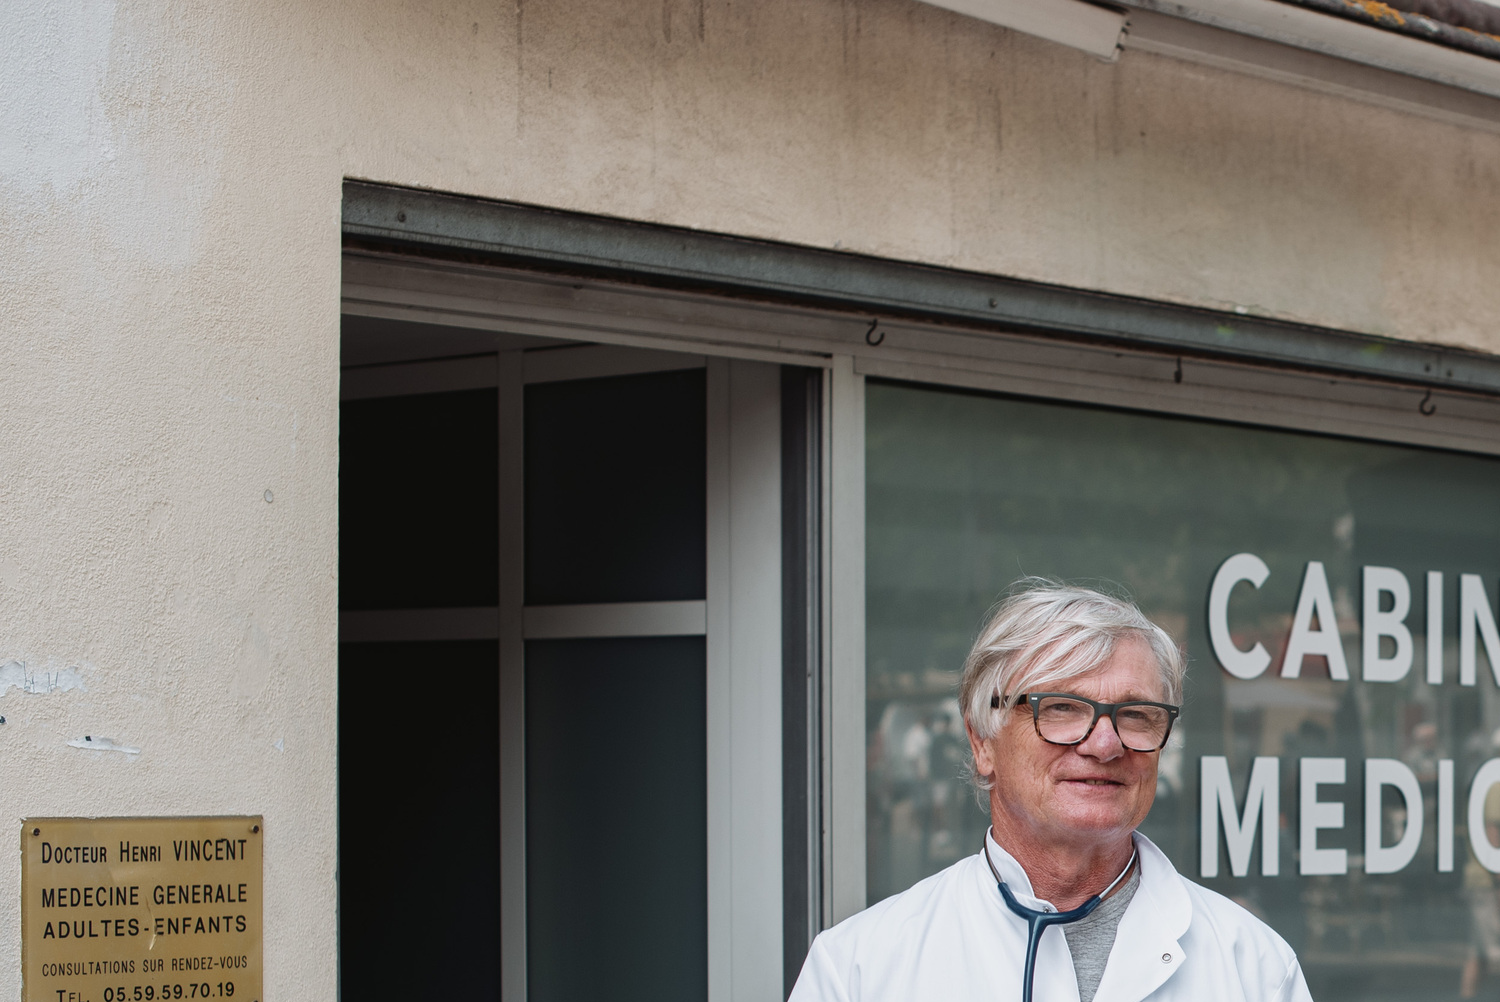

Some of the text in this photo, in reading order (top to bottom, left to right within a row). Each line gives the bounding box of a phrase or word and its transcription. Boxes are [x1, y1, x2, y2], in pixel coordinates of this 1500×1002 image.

[42, 842, 107, 864] DOCTEUR
[173, 839, 247, 862] VINCENT
[42, 884, 248, 908] MEDECINE GENERALE
[42, 955, 248, 977] CONSULTATIONS SUR RENDEZ-VOUS
[103, 981, 235, 1002] 05.59.59.70.19
